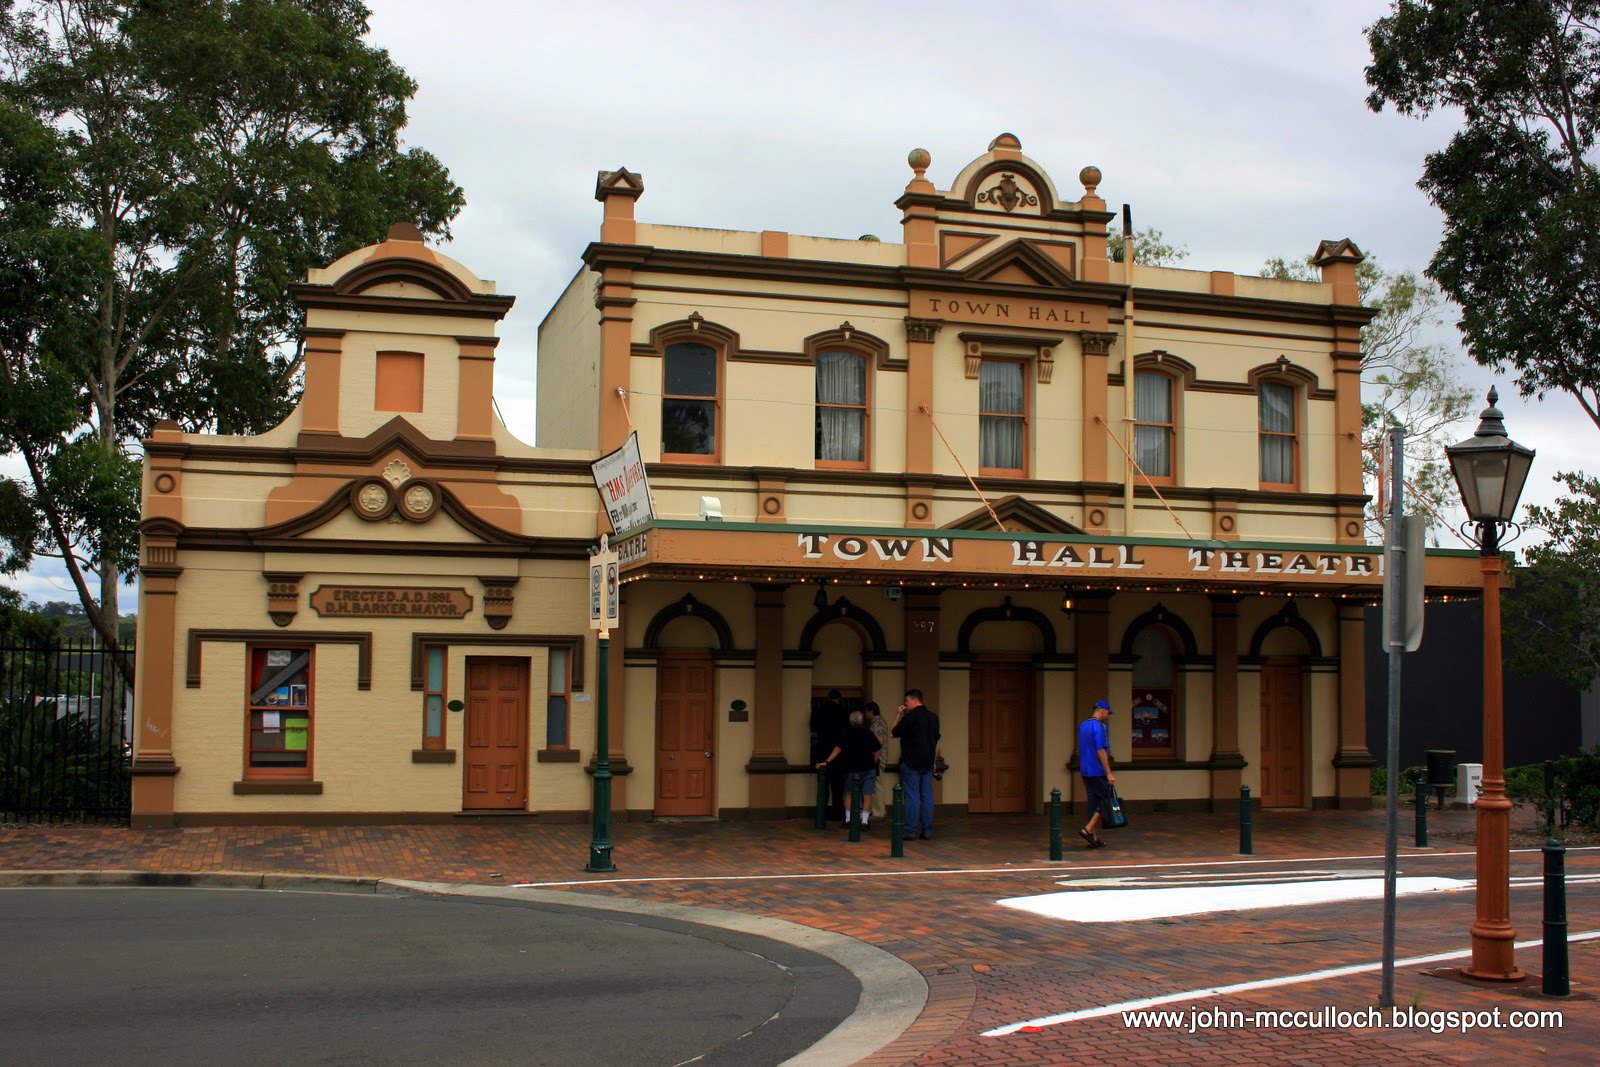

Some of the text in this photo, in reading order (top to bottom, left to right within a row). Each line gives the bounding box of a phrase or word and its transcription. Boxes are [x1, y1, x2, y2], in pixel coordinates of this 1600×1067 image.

[928, 298, 1091, 324] TOWN HALL
[798, 533, 1384, 577] TOWN HALL THEATR
